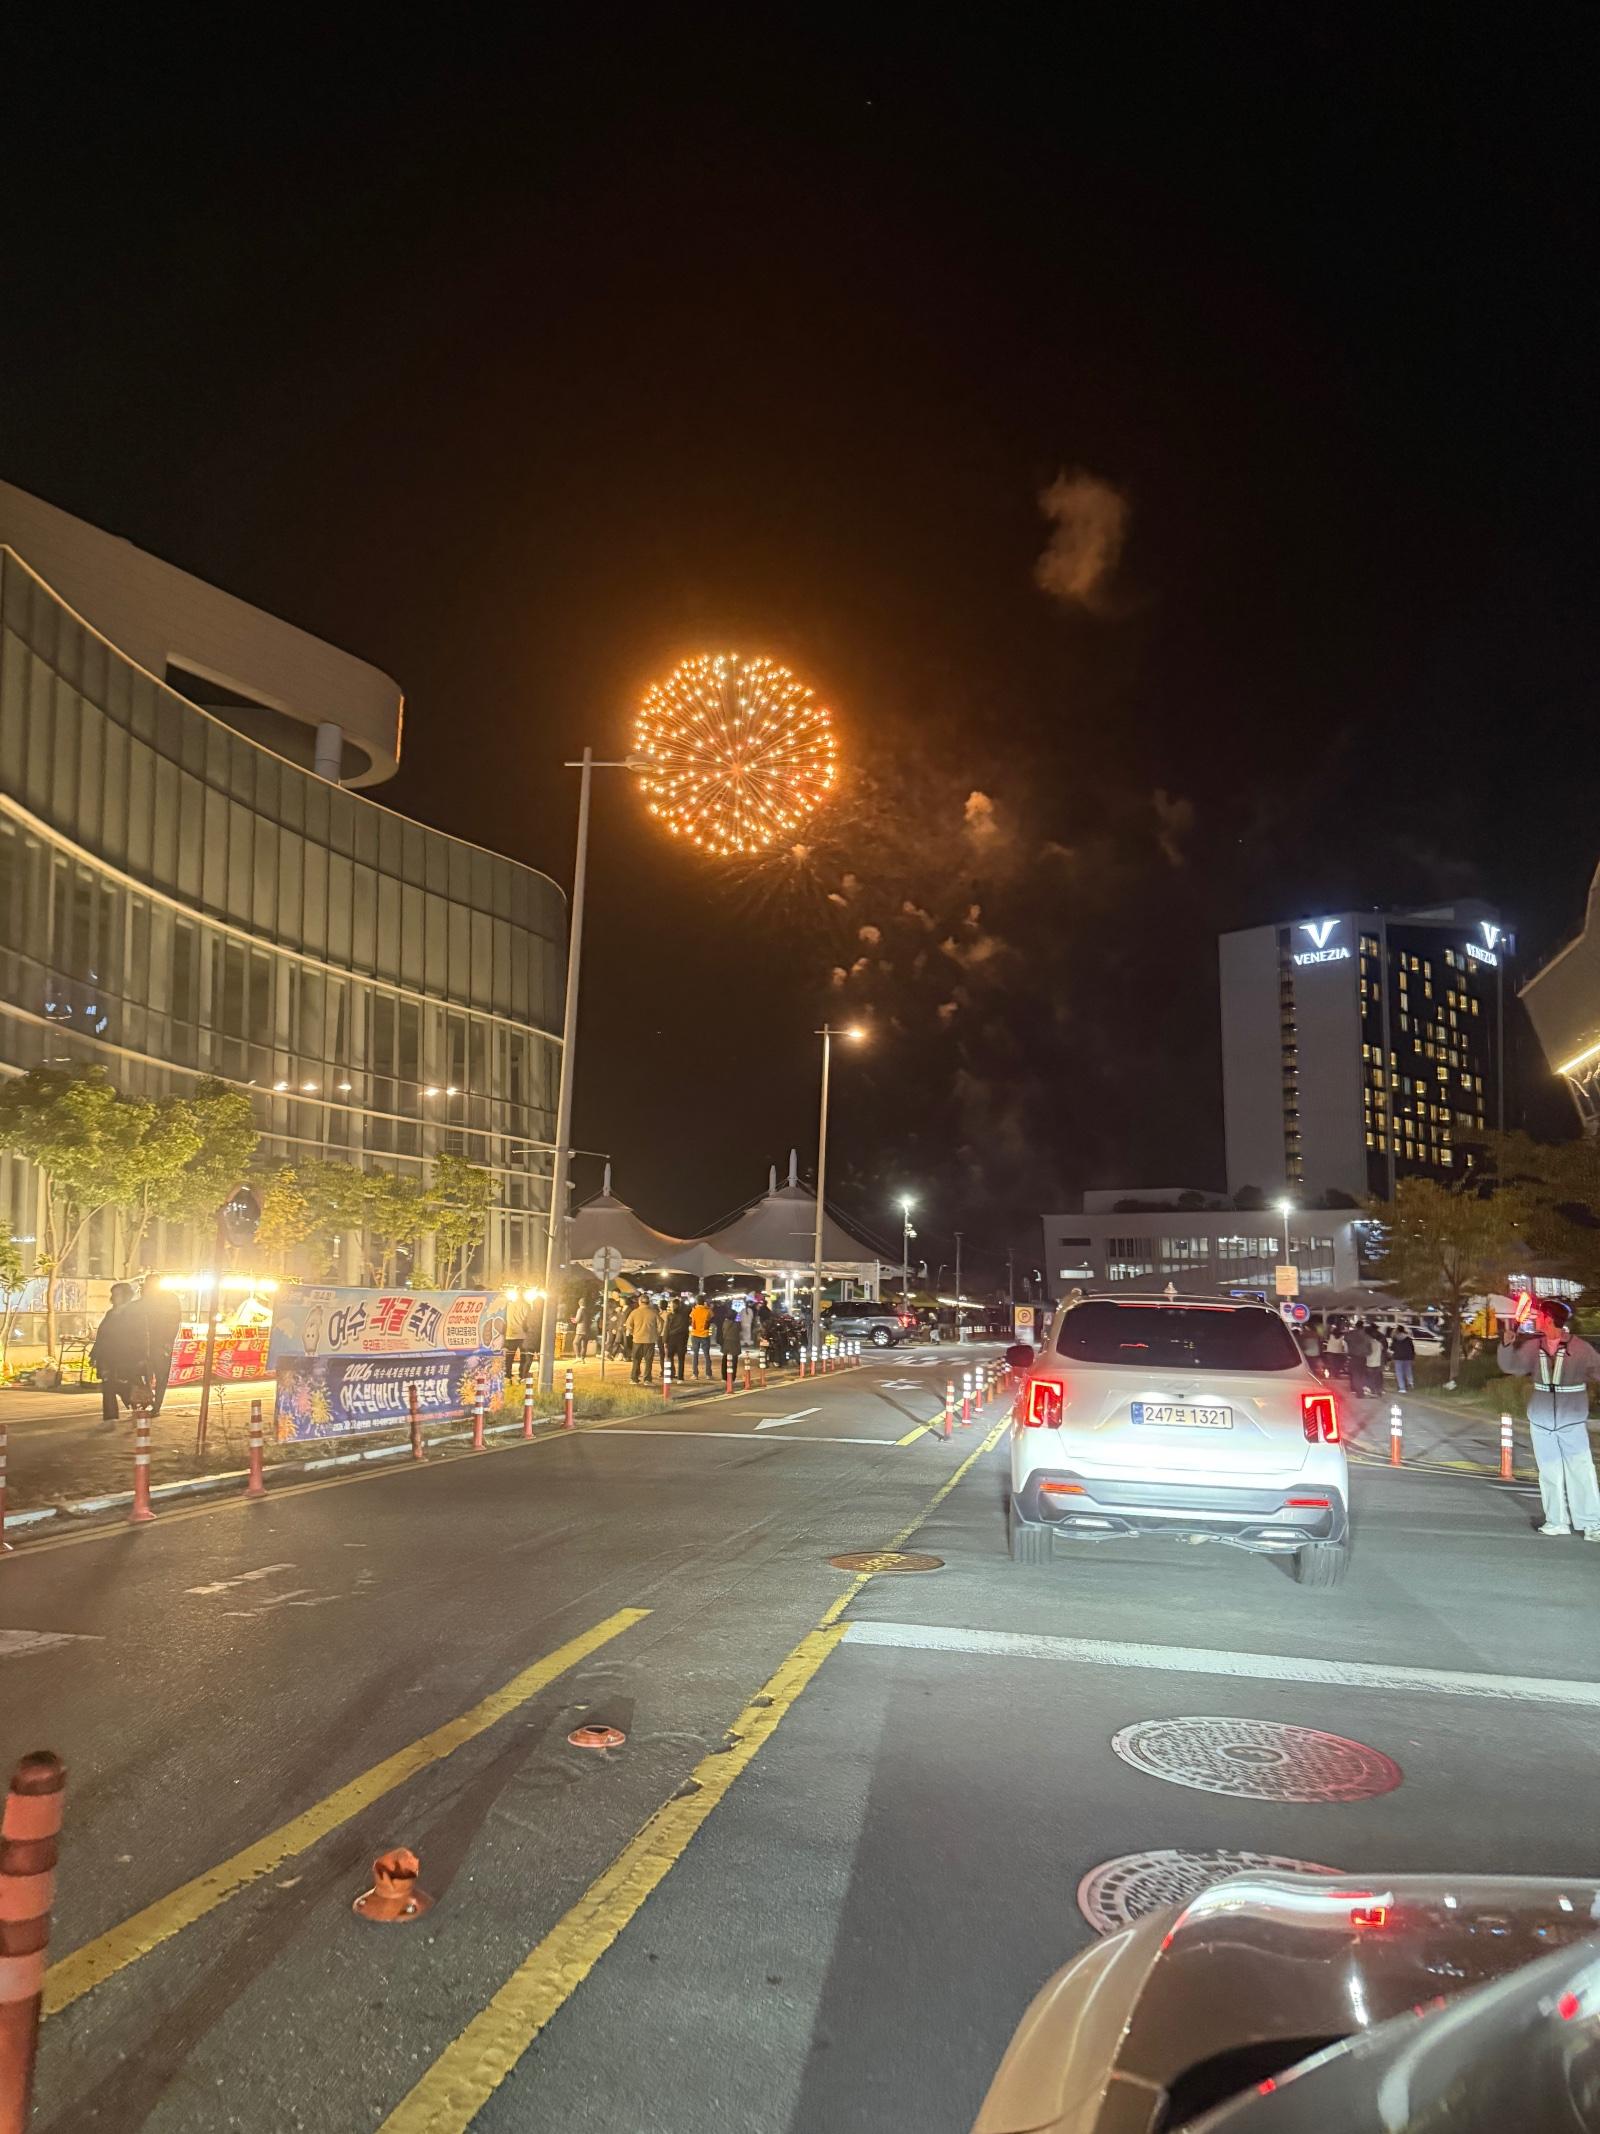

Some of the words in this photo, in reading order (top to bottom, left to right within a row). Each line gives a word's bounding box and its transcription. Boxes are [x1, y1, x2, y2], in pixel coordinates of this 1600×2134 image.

[1294, 947, 1350, 966] VENEZIA
[1466, 942, 1498, 967] VENEZIA
[328, 1302, 367, 1347] 여수
[408, 1302, 442, 1343] 축제
[343, 1363, 375, 1382] 2026
[340, 1381, 403, 1415] 여수밤바다
[1145, 1406, 1186, 1423] 247보
[1190, 1408, 1226, 1425] 1321
